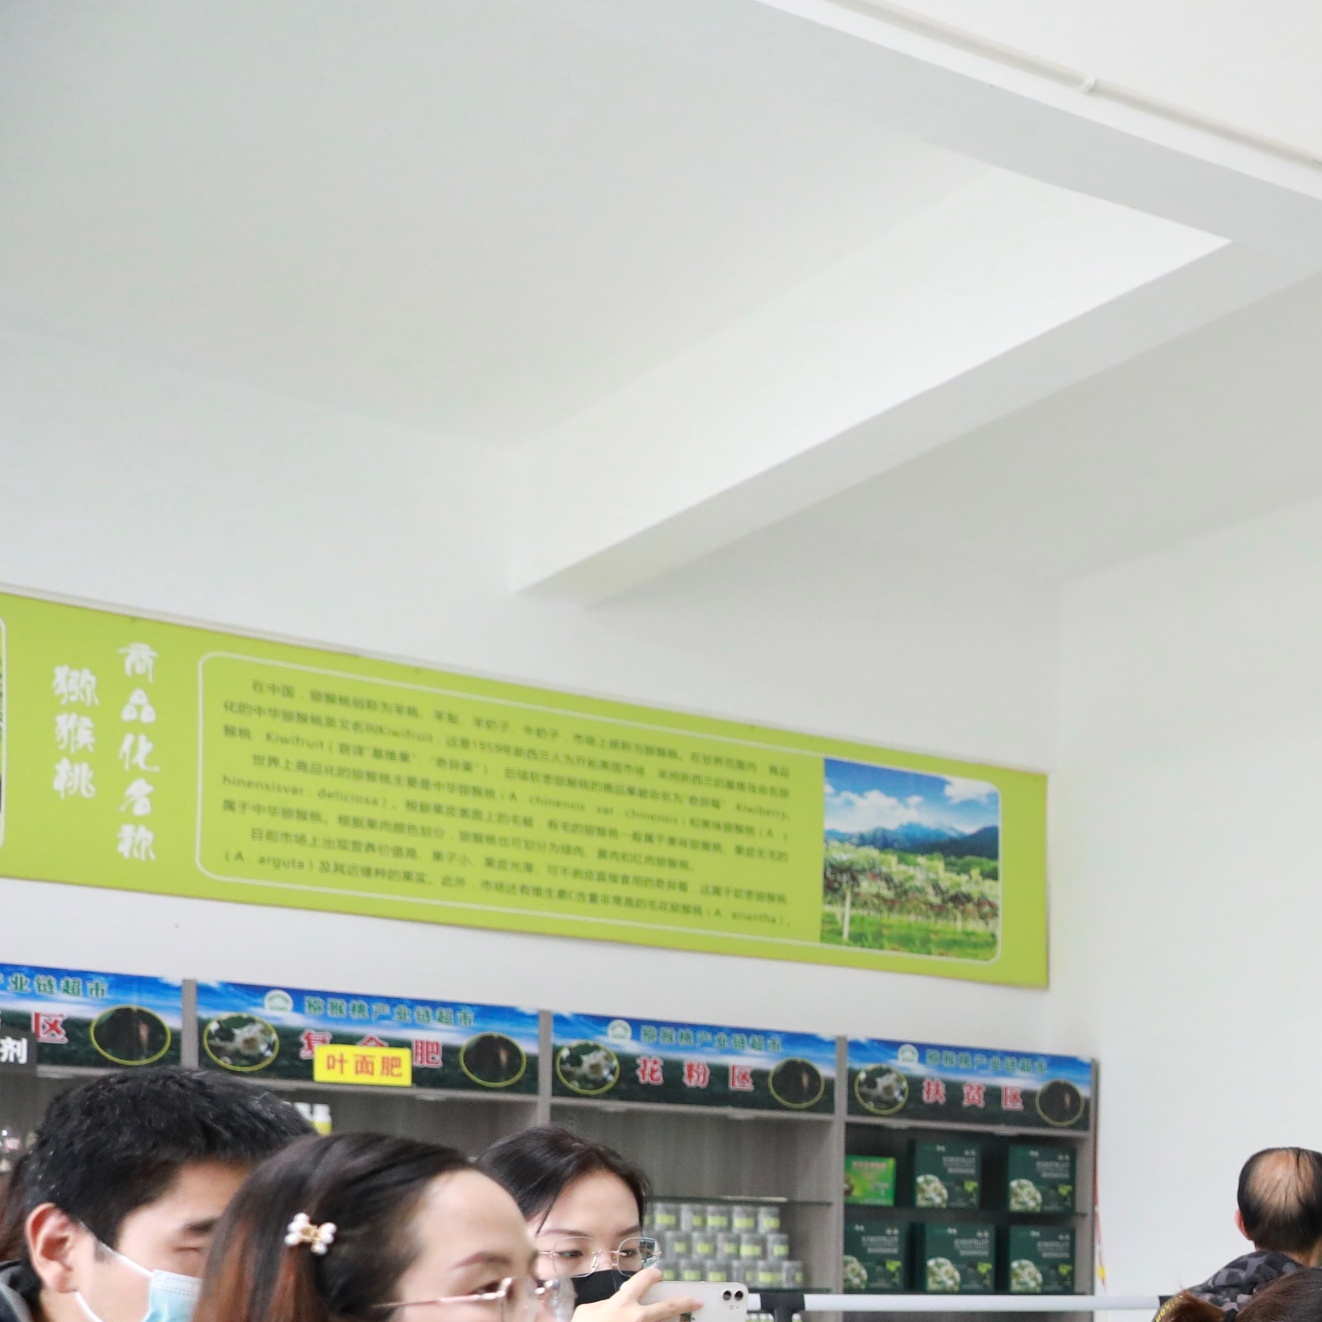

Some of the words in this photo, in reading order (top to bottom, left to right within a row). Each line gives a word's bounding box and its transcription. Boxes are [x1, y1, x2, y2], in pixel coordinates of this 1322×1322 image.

[52, 664, 99, 799] 猕猴桃
[117, 642, 160, 862] 商品化名称
[1, 970, 108, 998] 业链超市
[326, 1053, 403, 1078] 叶面肥
[636, 1056, 755, 1092] 花粉区
[922, 1077, 1025, 1112] 扶贫区
